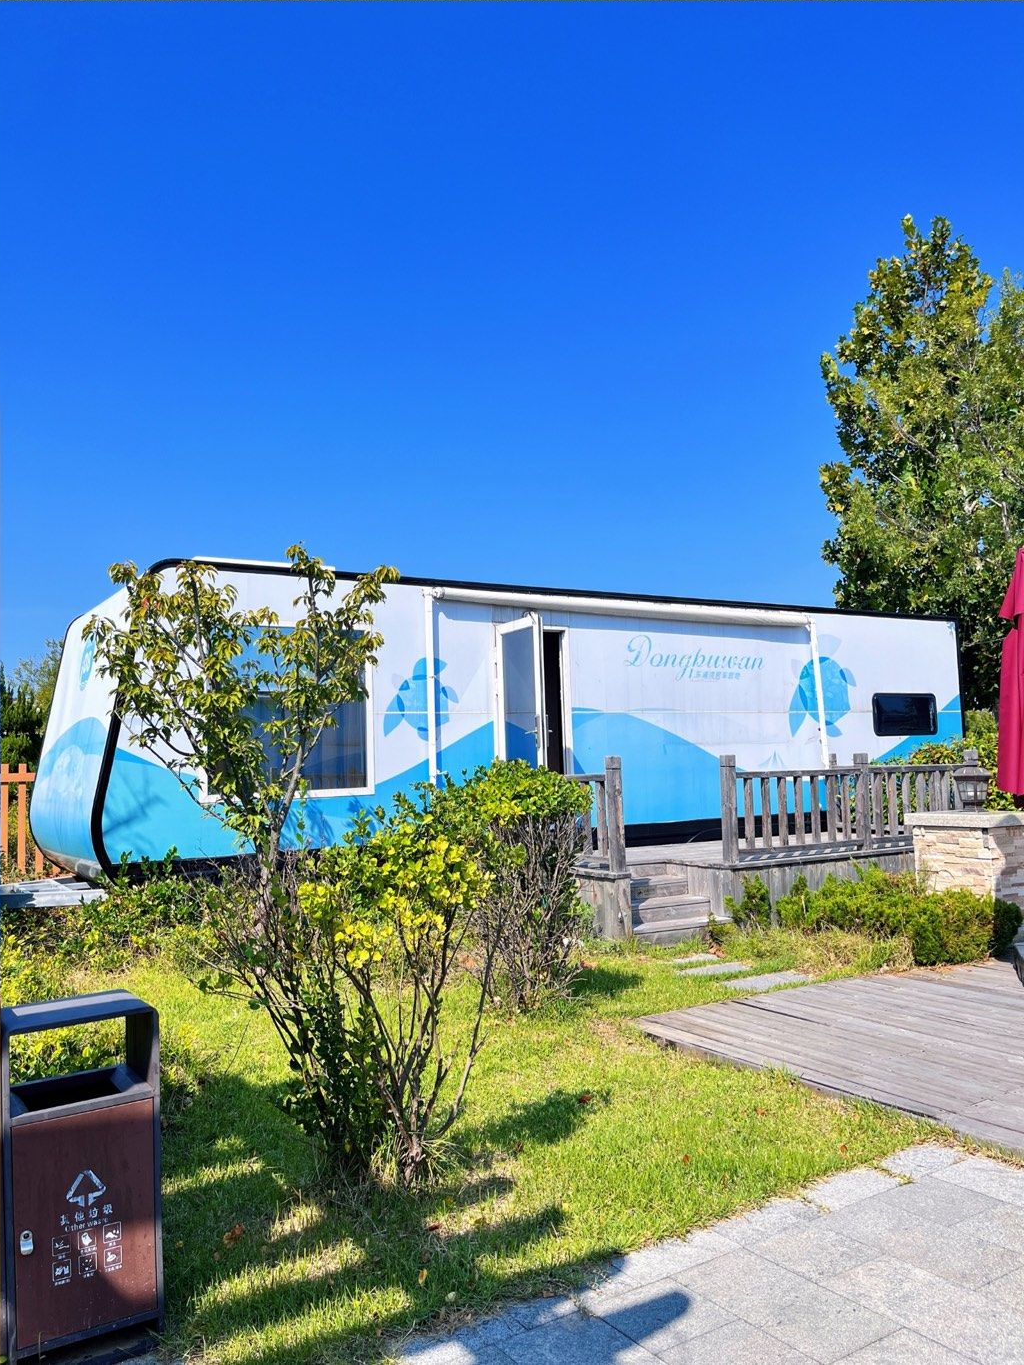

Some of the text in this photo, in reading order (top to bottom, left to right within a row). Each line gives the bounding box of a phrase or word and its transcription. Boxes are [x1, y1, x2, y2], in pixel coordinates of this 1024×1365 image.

[60, 1203, 113, 1226] 其他垃圾
[65, 1222, 86, 1232] Other
